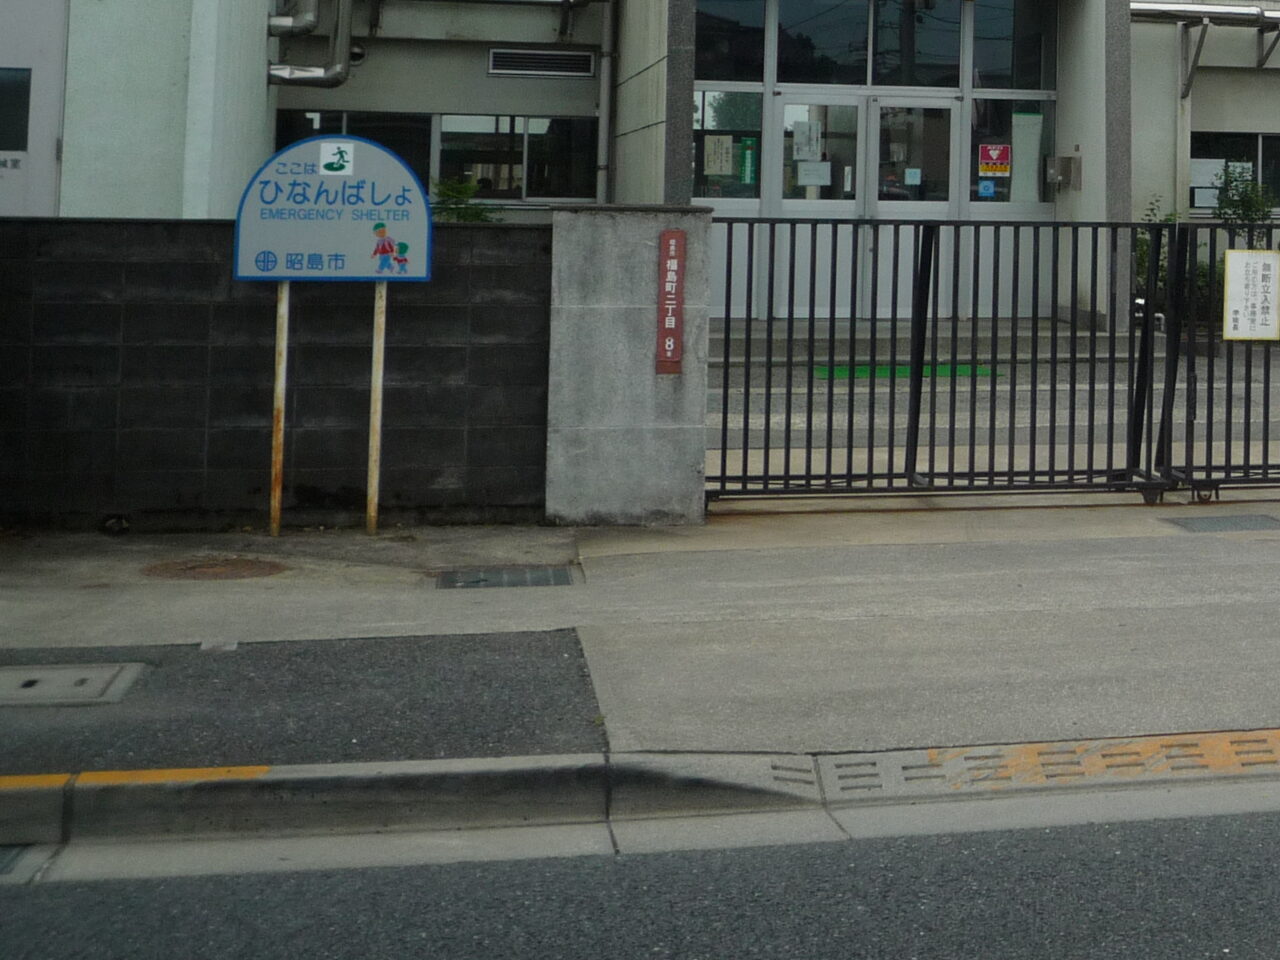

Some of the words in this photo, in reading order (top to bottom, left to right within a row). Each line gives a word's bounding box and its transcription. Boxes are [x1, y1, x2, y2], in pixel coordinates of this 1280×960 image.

[276, 162, 318, 176] ここは
[259, 180, 412, 206] ひなんばしょ
[260, 209, 343, 221] EMERGENCY
[352, 209, 410, 221] SHELTER
[285, 252, 346, 271] 昭島市
[664, 259, 678, 329] 福島町二丁目
[1260, 262, 1272, 327] 無断立入禁止
